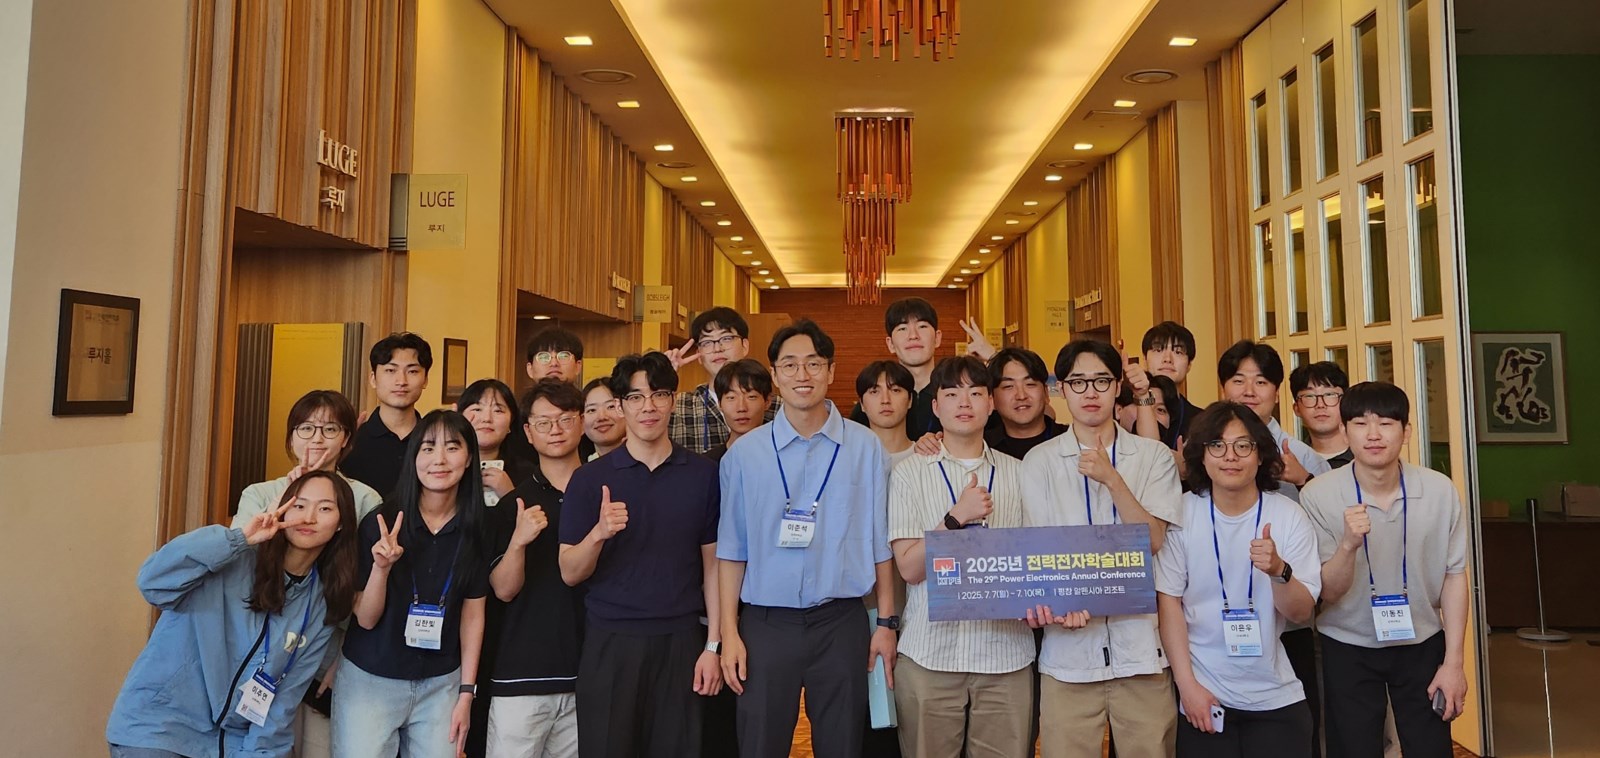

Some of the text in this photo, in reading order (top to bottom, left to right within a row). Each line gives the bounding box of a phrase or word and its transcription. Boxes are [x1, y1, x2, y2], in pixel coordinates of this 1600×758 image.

[316, 128, 358, 179] LUGE
[320, 186, 346, 213] 루지
[419, 191, 455, 208] LUGE
[427, 224, 445, 233] 루지
[87, 346, 112, 365] 루지홀
[966, 551, 1145, 573] 2025년 전력전자학술대회
[967, 576, 983, 585] The
[1000, 574, 1025, 583] Power
[1026, 572, 1070, 583] Electronics
[1071, 571, 1099, 581] Annual
[1100, 570, 1146, 580] Conference
[1104, 585, 1126, 595] 리조트
